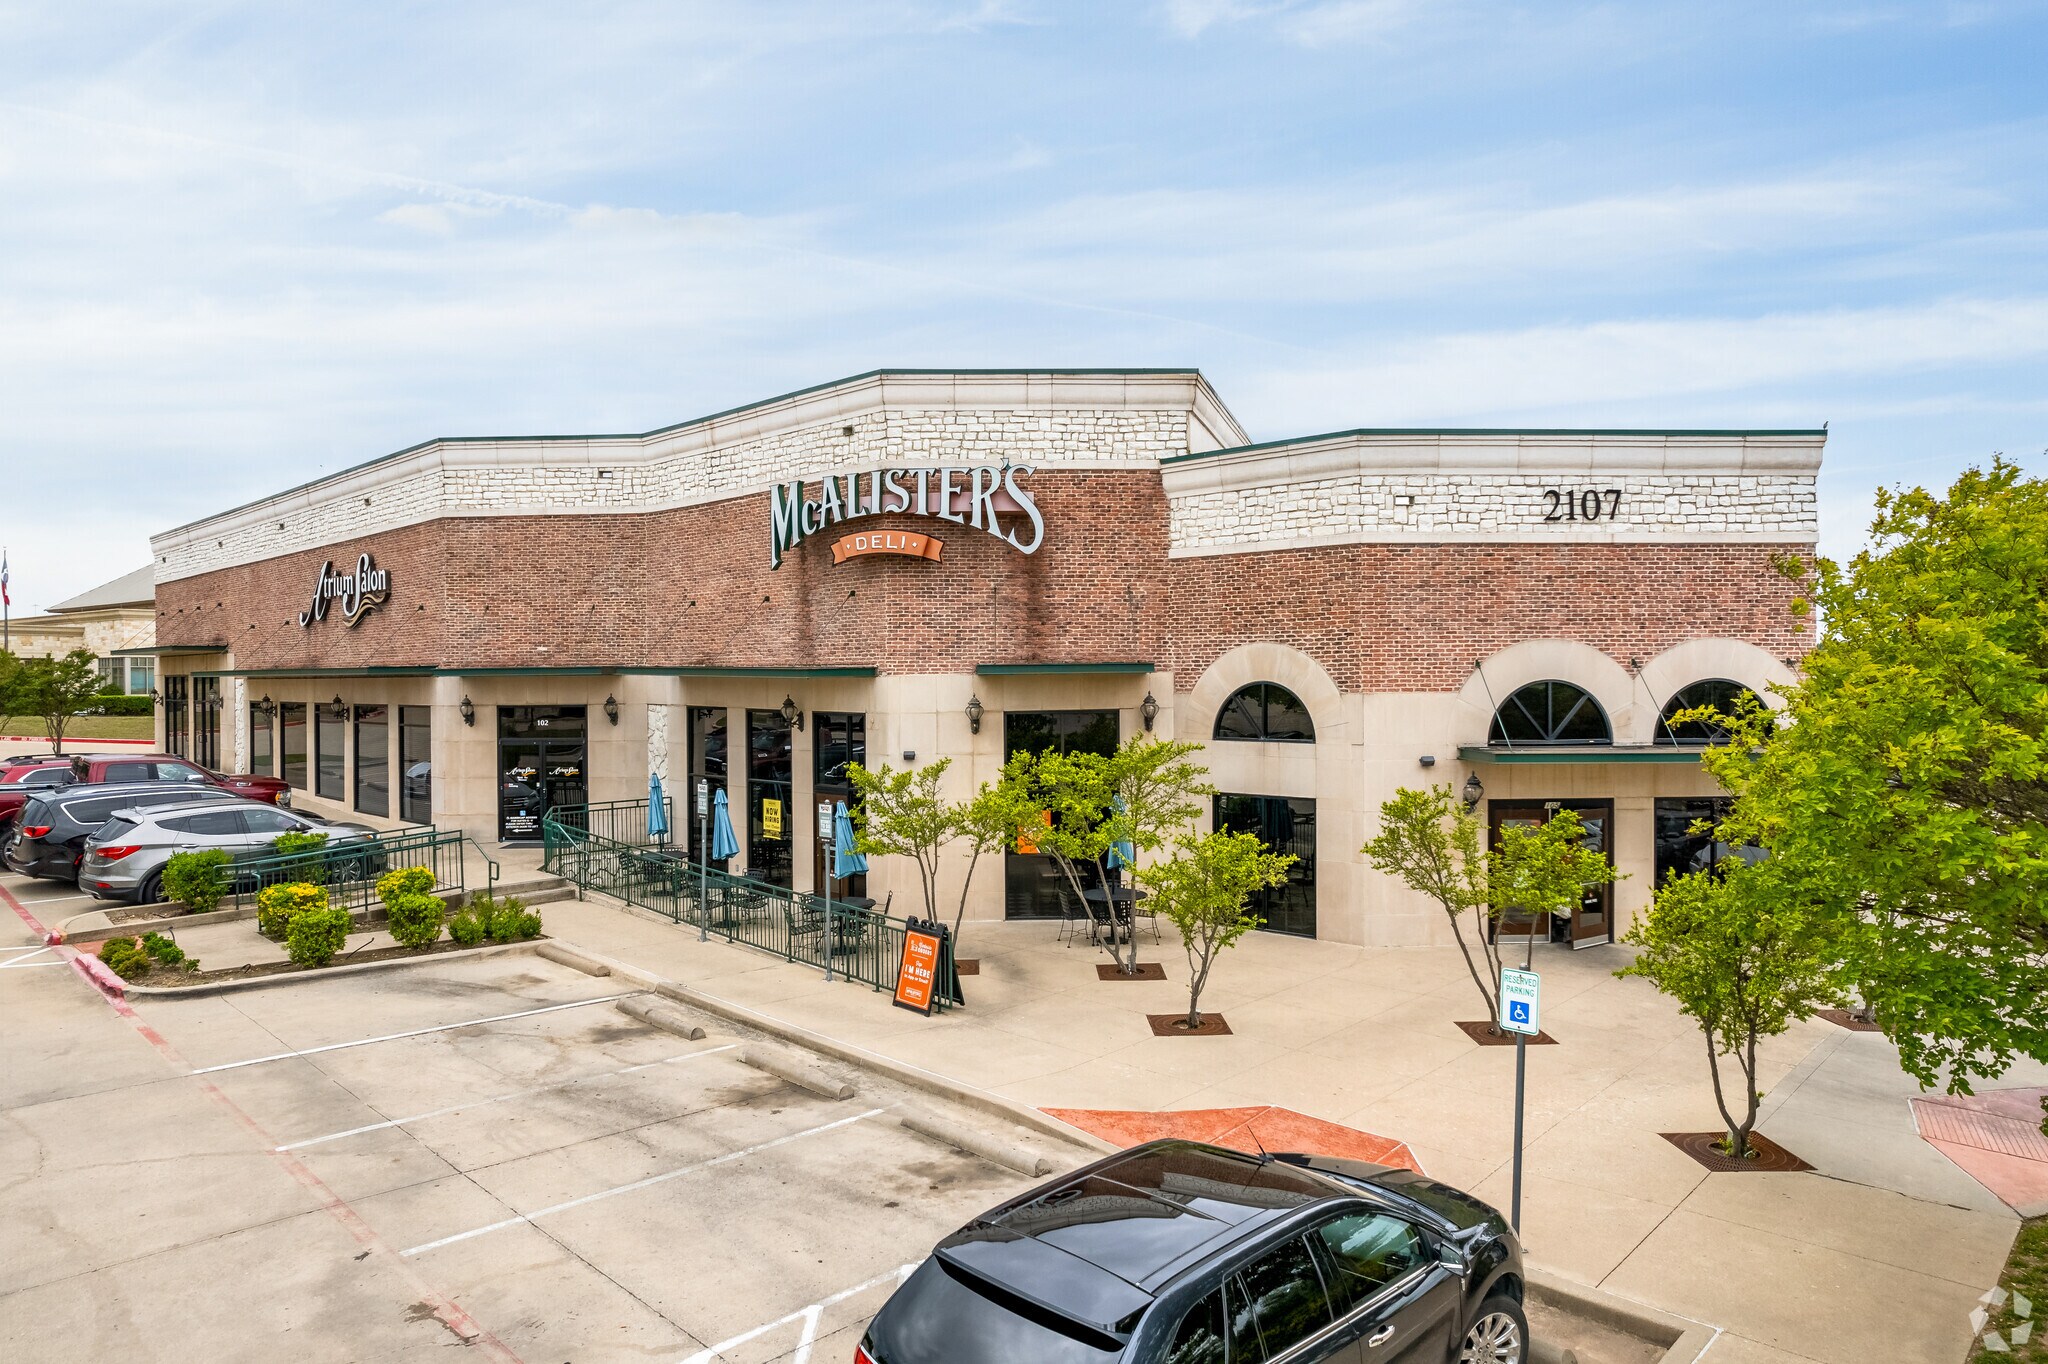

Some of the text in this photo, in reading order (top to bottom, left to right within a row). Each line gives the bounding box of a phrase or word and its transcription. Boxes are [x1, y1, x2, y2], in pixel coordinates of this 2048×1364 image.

[1543, 489, 1622, 521] 2107
[855, 535, 906, 550] DELI
[299, 553, 388, 627] Atrium Salon
[765, 807, 779, 816] NOW
[764, 815, 780, 824] HIRING
[905, 963, 931, 979] I'M HERE
[1504, 974, 1537, 988] RESERVED
[1505, 984, 1535, 997] PARKING
